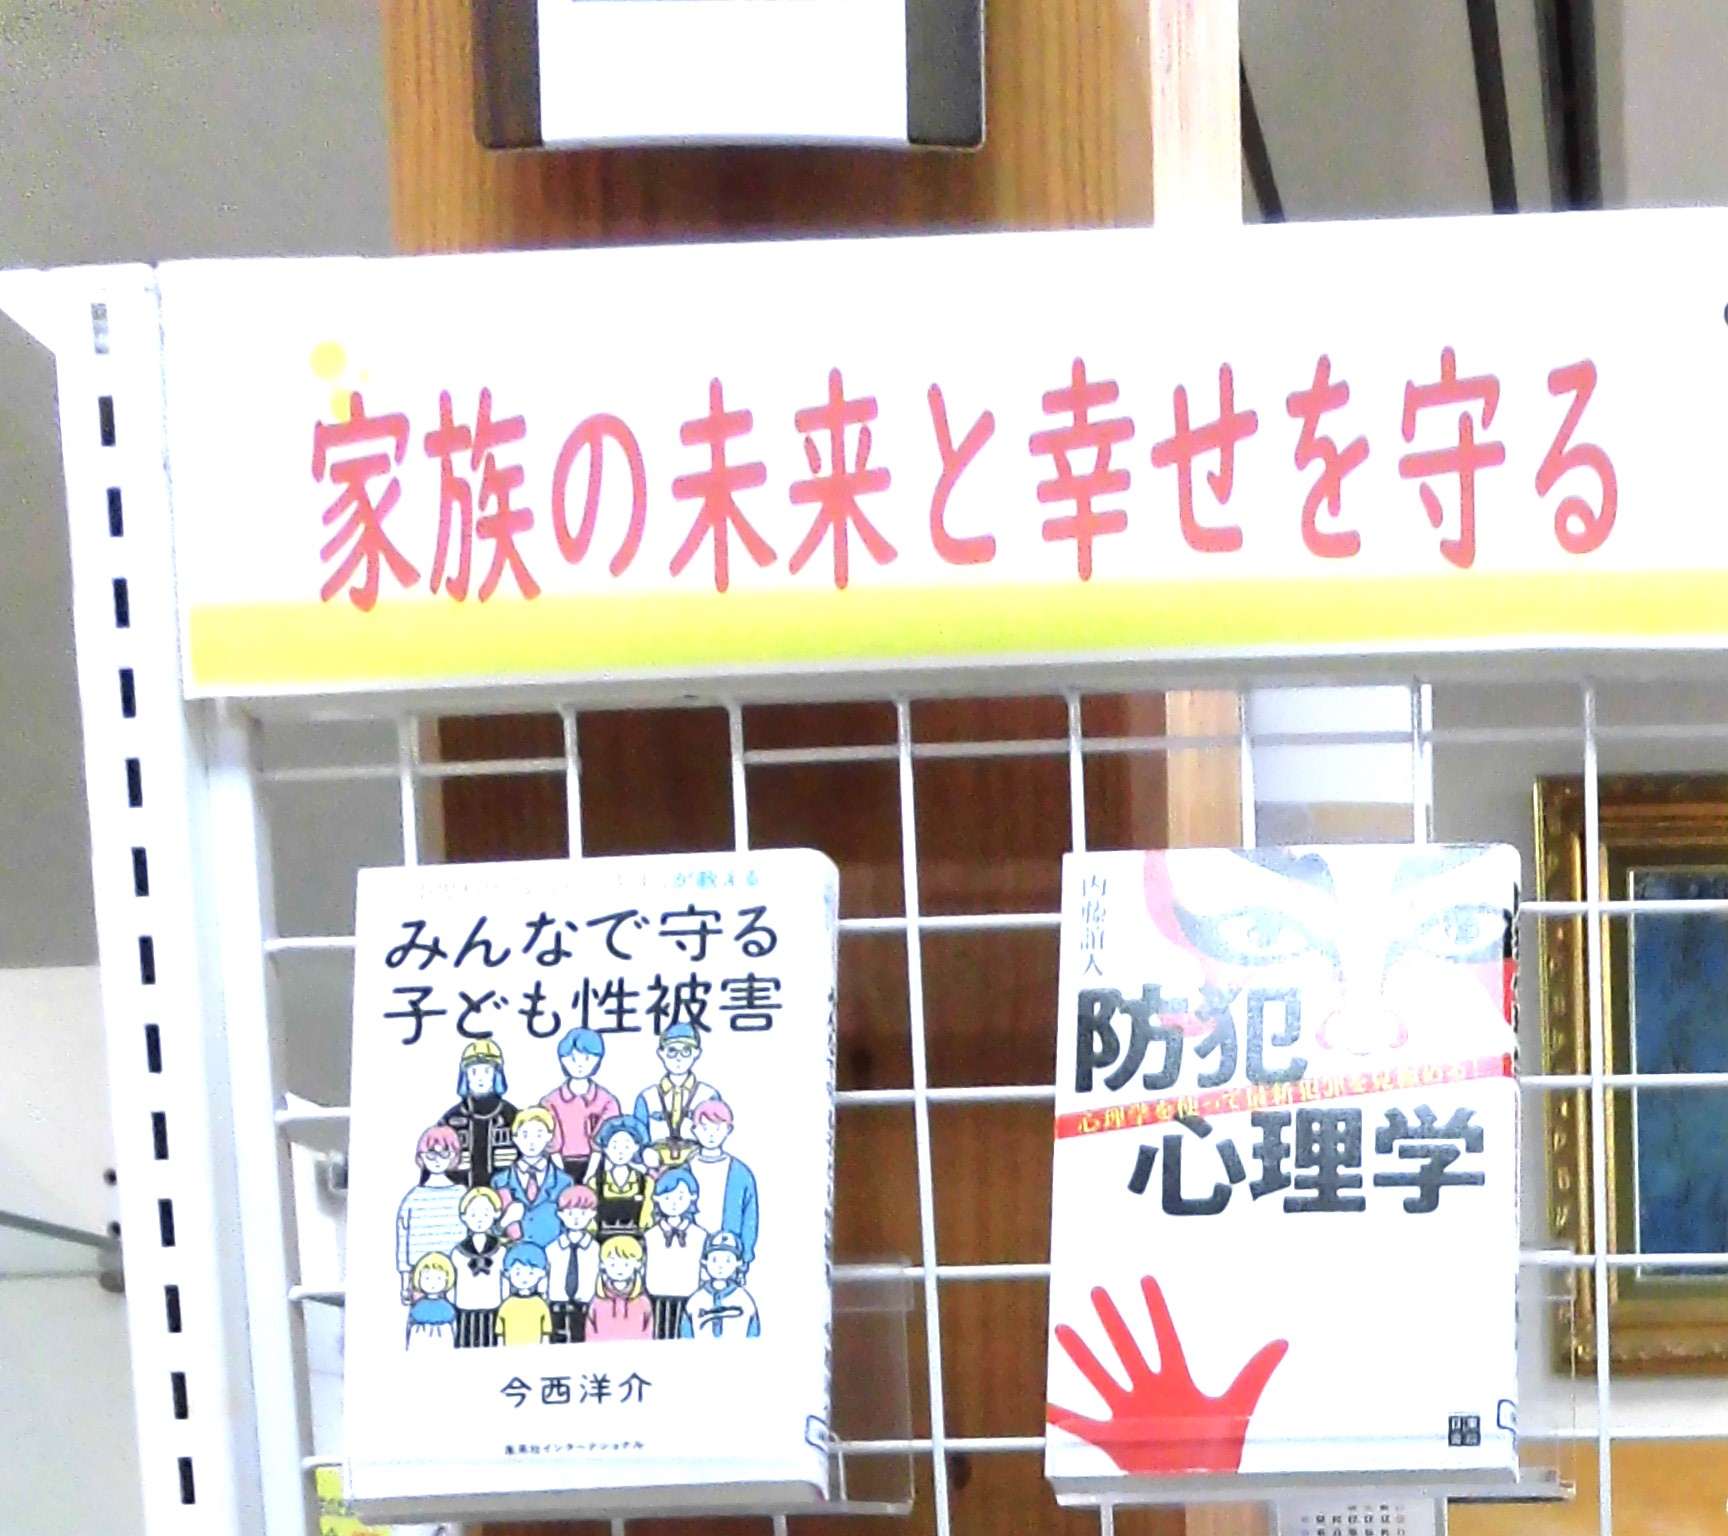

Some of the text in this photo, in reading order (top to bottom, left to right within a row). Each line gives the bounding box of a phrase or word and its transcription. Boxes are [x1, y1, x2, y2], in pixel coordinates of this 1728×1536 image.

[308, 348, 1620, 613] 家族の未来と幸せを守る
[384, 905, 779, 969] みんなで守る
[382, 973, 782, 1045] 子ども性被害
[1075, 983, 1308, 1094] 防犯
[1128, 1103, 1486, 1215] 心理学
[500, 1372, 652, 1407] 今西洋介
